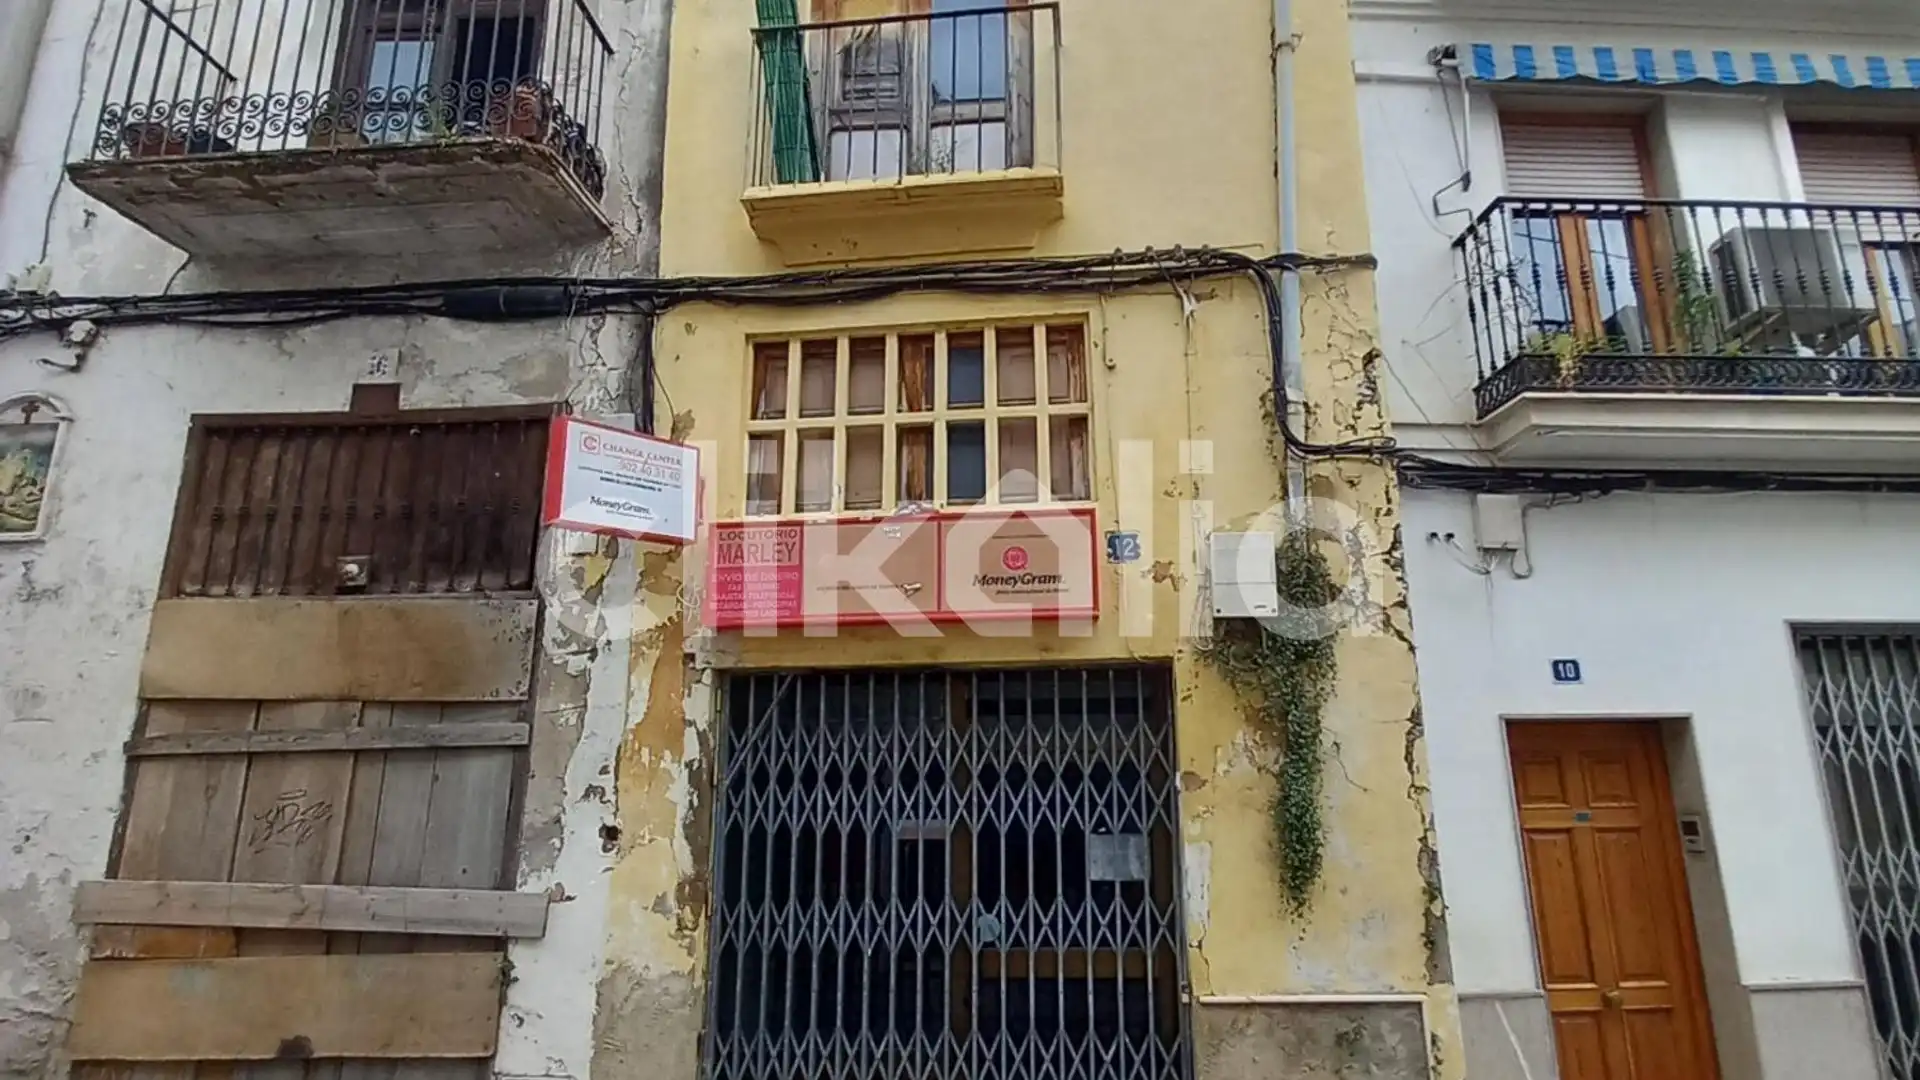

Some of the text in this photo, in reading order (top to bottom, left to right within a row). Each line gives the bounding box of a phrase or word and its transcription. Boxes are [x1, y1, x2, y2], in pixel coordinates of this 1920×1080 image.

[646, 450, 682, 466] CENTER
[719, 528, 798, 542] LOCUTORIO
[717, 541, 797, 565] MARLEY
[1115, 537, 1136, 558] 12
[1557, 662, 1576, 679] 10
